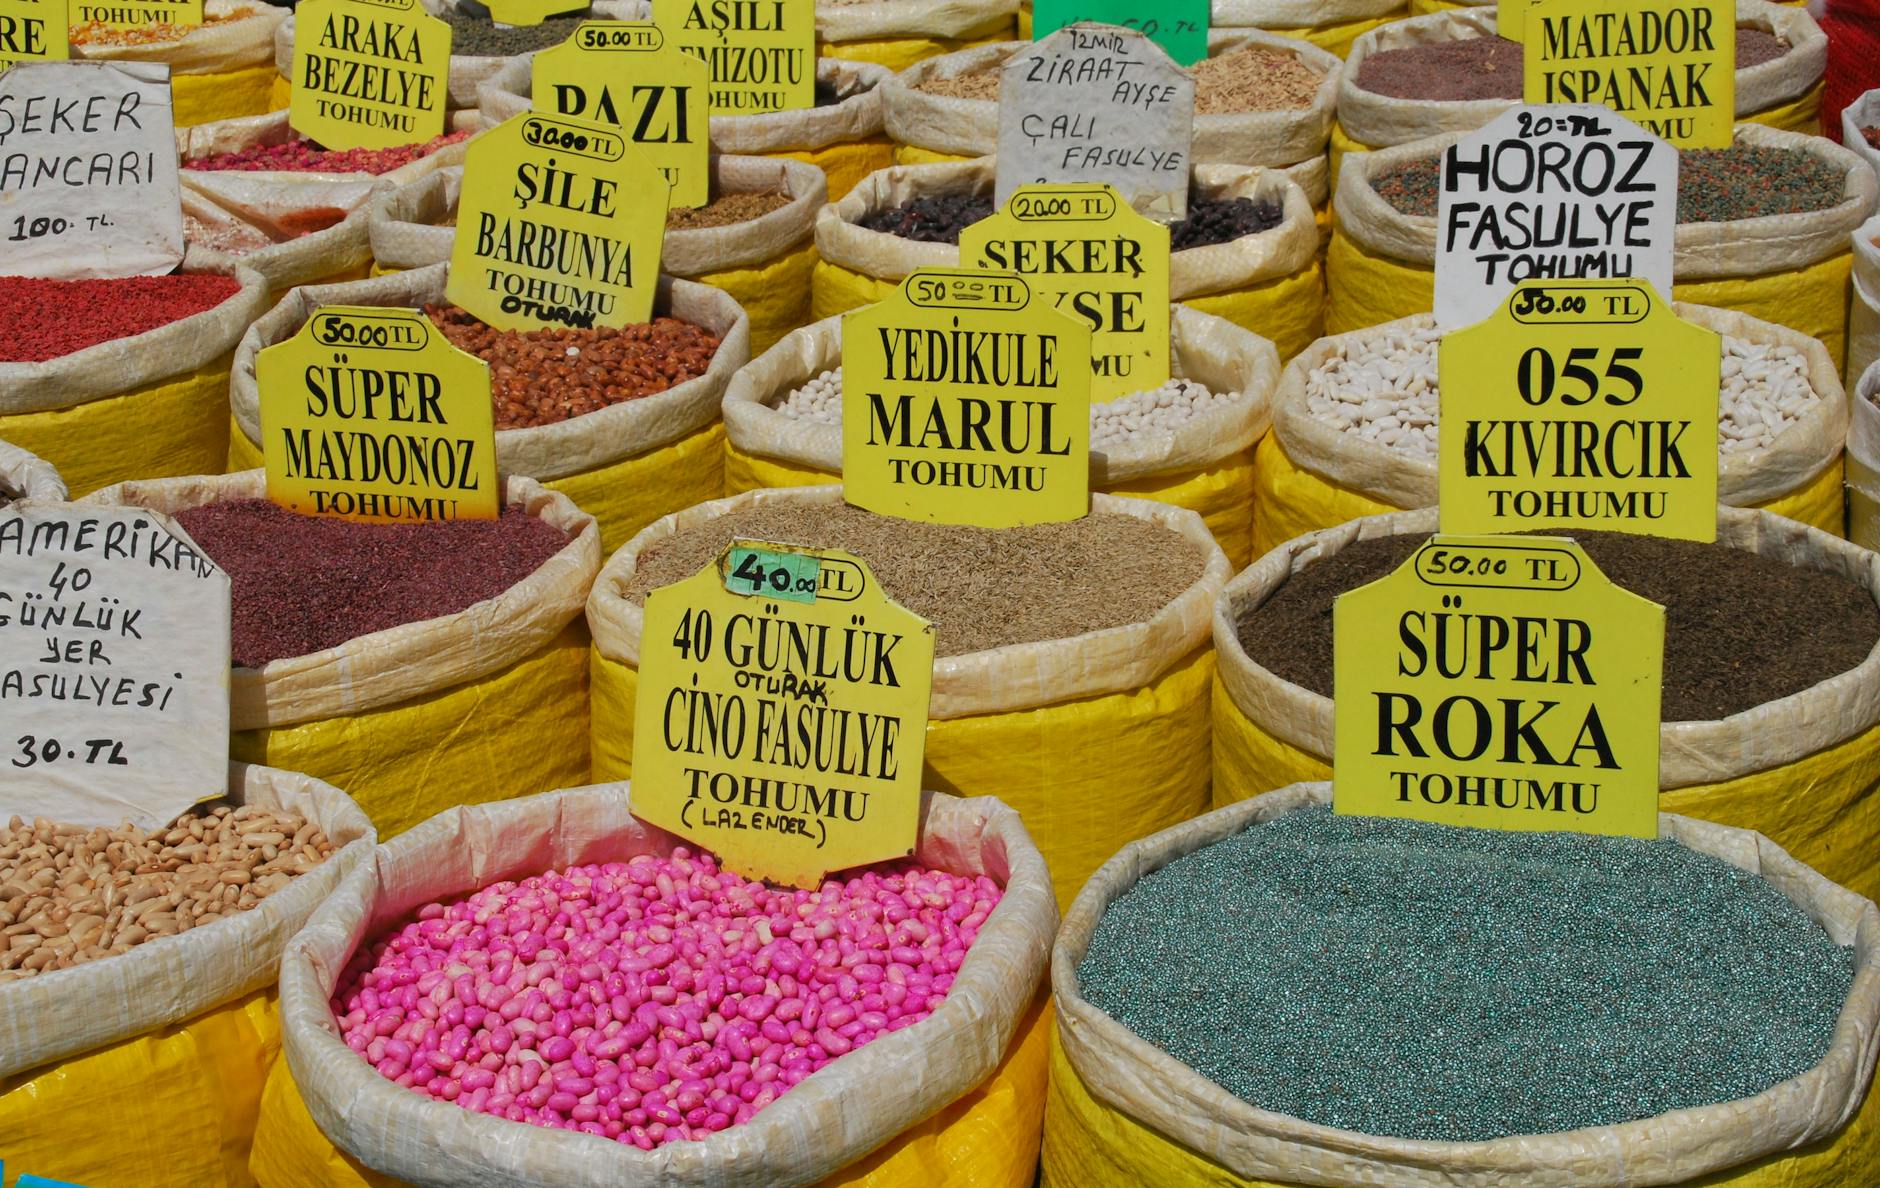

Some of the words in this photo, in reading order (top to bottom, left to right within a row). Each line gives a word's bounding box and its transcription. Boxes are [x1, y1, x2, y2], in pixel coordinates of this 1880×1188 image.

[79, 6, 176, 24] TOHUMU
[683, 0, 786, 37] AŞILI
[1541, 7, 1715, 61] MATADOR
[0, 16, 46, 55] RE
[318, 11, 423, 64] ARAKA
[584, 30, 631, 47] 50.00
[634, 32, 658, 46] TL
[679, 37, 804, 85] MİZOTU
[1026, 54, 1145, 85] ZİRAAT
[303, 53, 435, 111] BEZELYE
[709, 90, 786, 109] HUMU
[1112, 81, 1177, 111] AYŞE
[1543, 62, 1714, 112] ISPANAK
[0, 91, 141, 146] ŞEKER
[316, 99, 416, 133] TOHUMU
[1021, 114, 1096, 147] ÇALI
[591, 137, 617, 156] TL
[1062, 146, 1184, 171] FASULYE
[0, 151, 153, 191] ANCARI
[1445, 139, 1657, 197] HOROZ
[513, 158, 618, 219] ŞİLE
[1081, 198, 1108, 215] TL
[1446, 200, 1654, 252] FASULYE
[474, 211, 633, 288] BARBUNYA
[1475, 250, 1632, 285] TOHUMU
[486, 268, 617, 315] TOHUMU
[988, 284, 1021, 304] TL
[1603, 296, 1640, 316] TL
[322, 317, 387, 346] 50.00
[389, 325, 420, 344] TL
[878, 315, 1059, 388] YEDİKULE
[305, 352, 448, 425] SÜPER
[1517, 347, 1644, 406] 055
[865, 393, 1072, 456] MARUL
[281, 427, 478, 491] MAYDONOZ
[1464, 419, 1692, 479] KIVIRCIK
[888, 458, 1048, 492] TOHUMU
[309, 490, 459, 521] TOHUMU
[1488, 490, 1668, 519] TOHUMU
[0, 517, 215, 579] AMERİKAN
[1426, 551, 1507, 575] 50.00
[1525, 558, 1567, 582] TL
[49, 561, 92, 601] 40
[732, 553, 816, 593] 40.00
[820, 568, 854, 593] TL
[39, 636, 112, 665] YER
[673, 607, 713, 663] 40
[724, 603, 904, 688] GÜNLÜK
[1399, 595, 1596, 685] SÜPER
[2, 670, 183, 711] ASULYESİ
[734, 670, 828, 706] OTURAK
[663, 672, 746, 760] CİNO
[753, 698, 900, 781] FASULYE
[1370, 691, 1622, 770] ROKA
[683, 767, 871, 822] TOHUMU
[1390, 771, 1601, 814] TOHUMU
